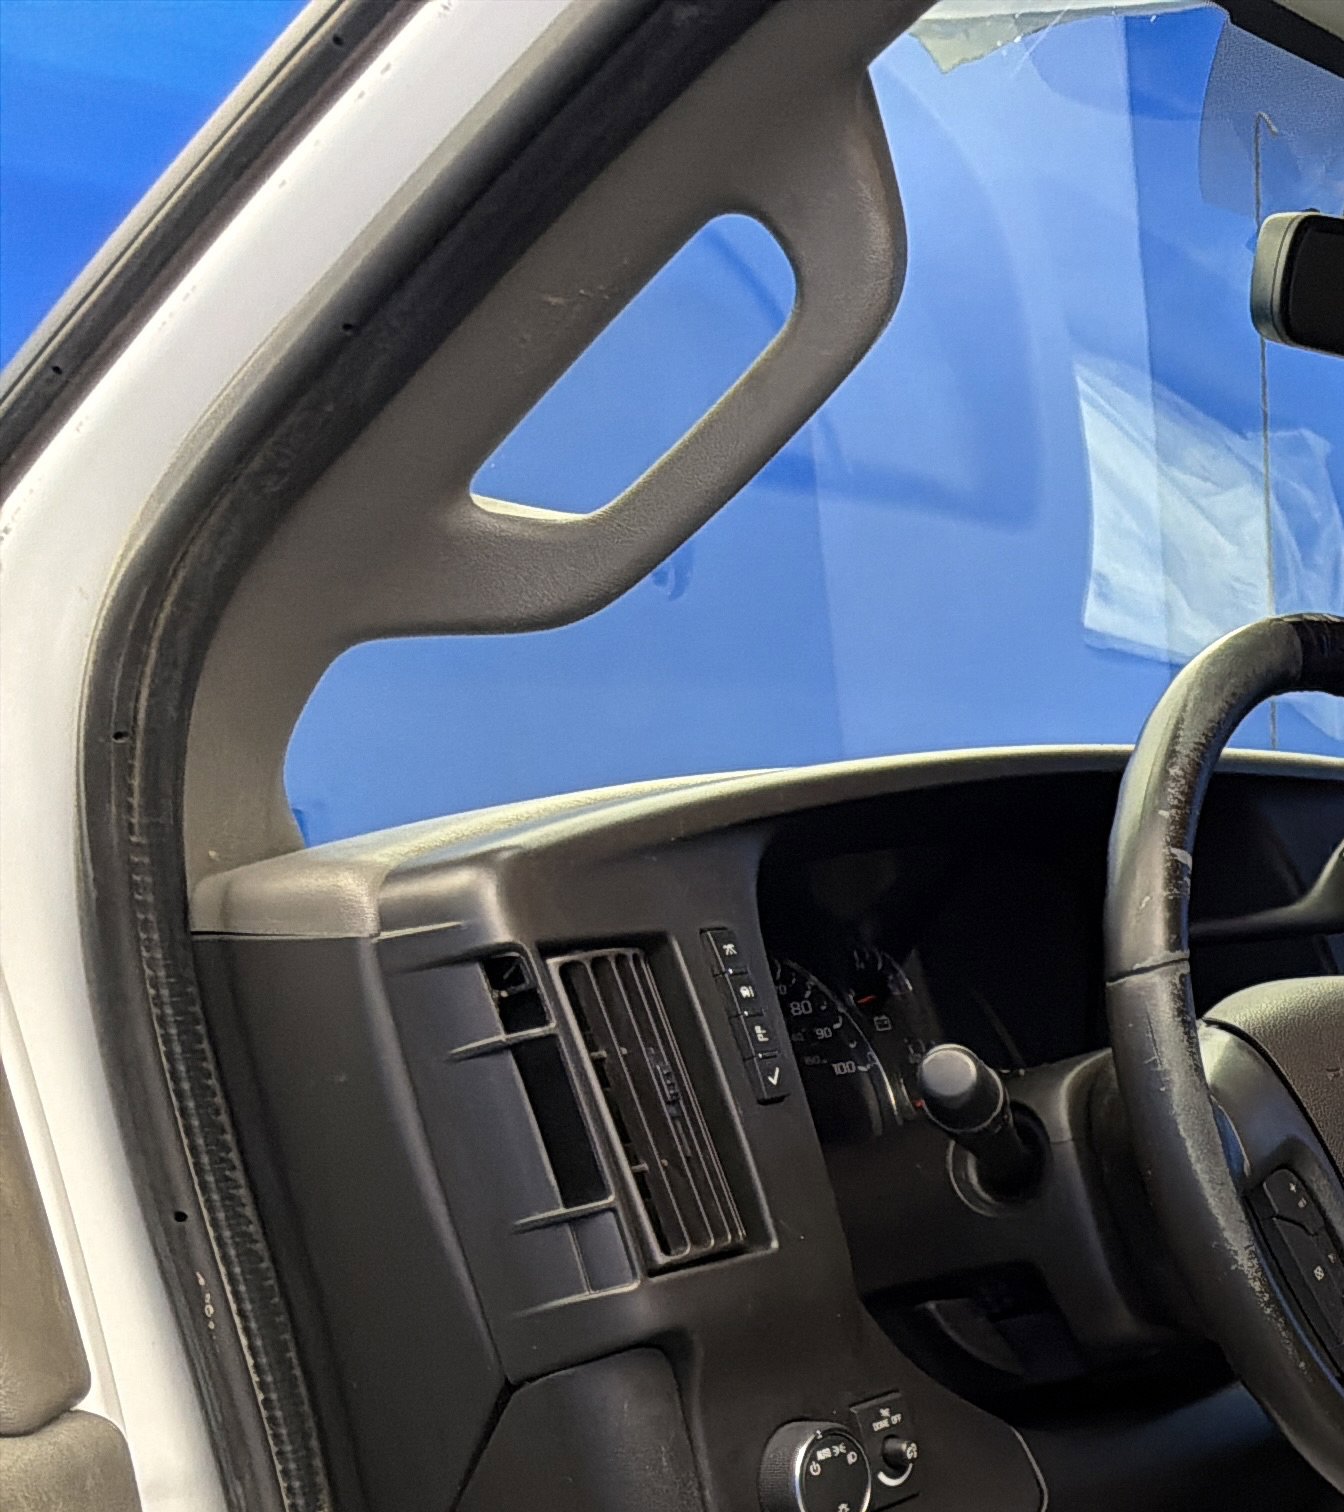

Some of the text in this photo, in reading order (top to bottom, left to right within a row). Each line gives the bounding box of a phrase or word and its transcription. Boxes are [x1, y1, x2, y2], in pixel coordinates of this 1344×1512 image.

[789, 999, 813, 1016] 80
[815, 1027, 832, 1040] 90
[831, 1060, 856, 1076] 100
